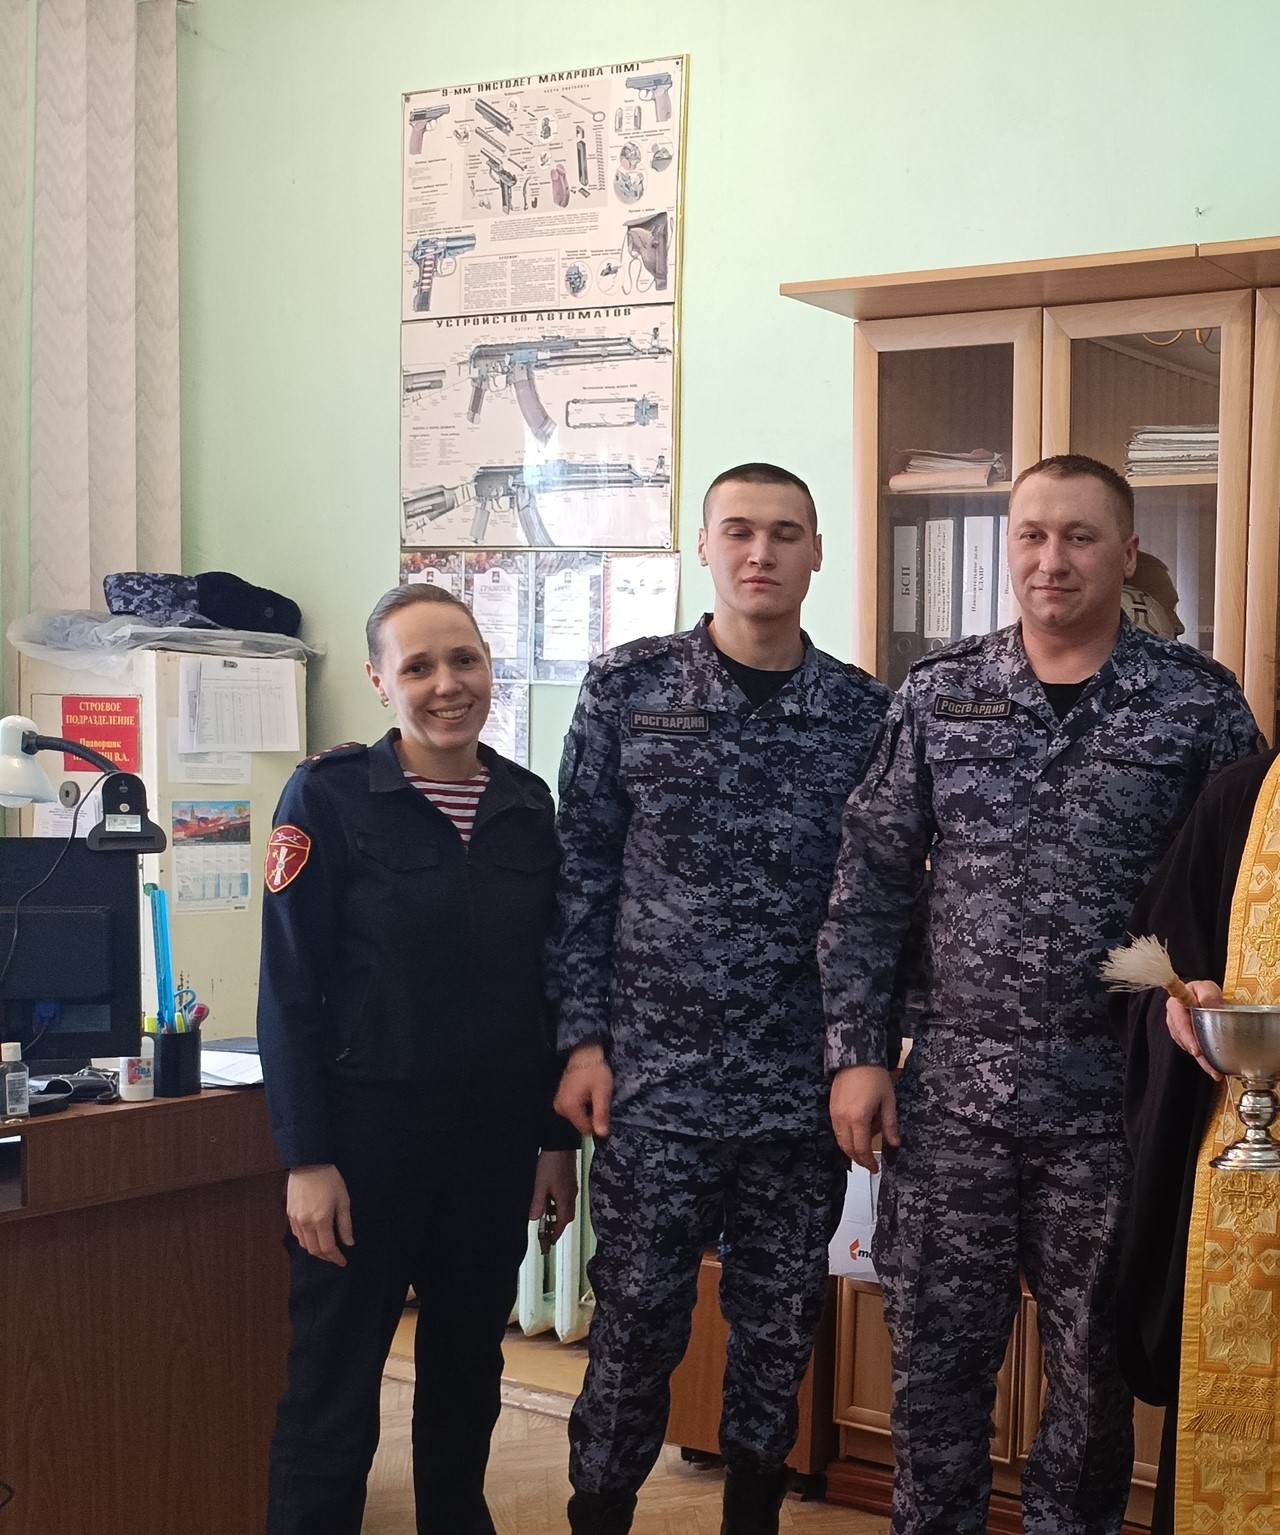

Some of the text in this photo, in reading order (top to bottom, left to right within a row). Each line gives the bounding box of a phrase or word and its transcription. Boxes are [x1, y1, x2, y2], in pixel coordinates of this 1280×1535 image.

[477, 76, 532, 93] ПИСТОЛЕТ
[538, 67, 604, 84] МАКАРОВА
[436, 308, 631, 328] УСТРОЙСТВО АВТОМАТОВ
[901, 566, 911, 596] БСП
[79, 701, 122, 712] СТРОЕВОЕ
[941, 700, 1006, 715] РОСГВАРДИЯ
[65, 714, 136, 726] ПОДРАЗДЕЛЕНИЕ
[634, 714, 705, 730] РОСГВАРДИЯ
